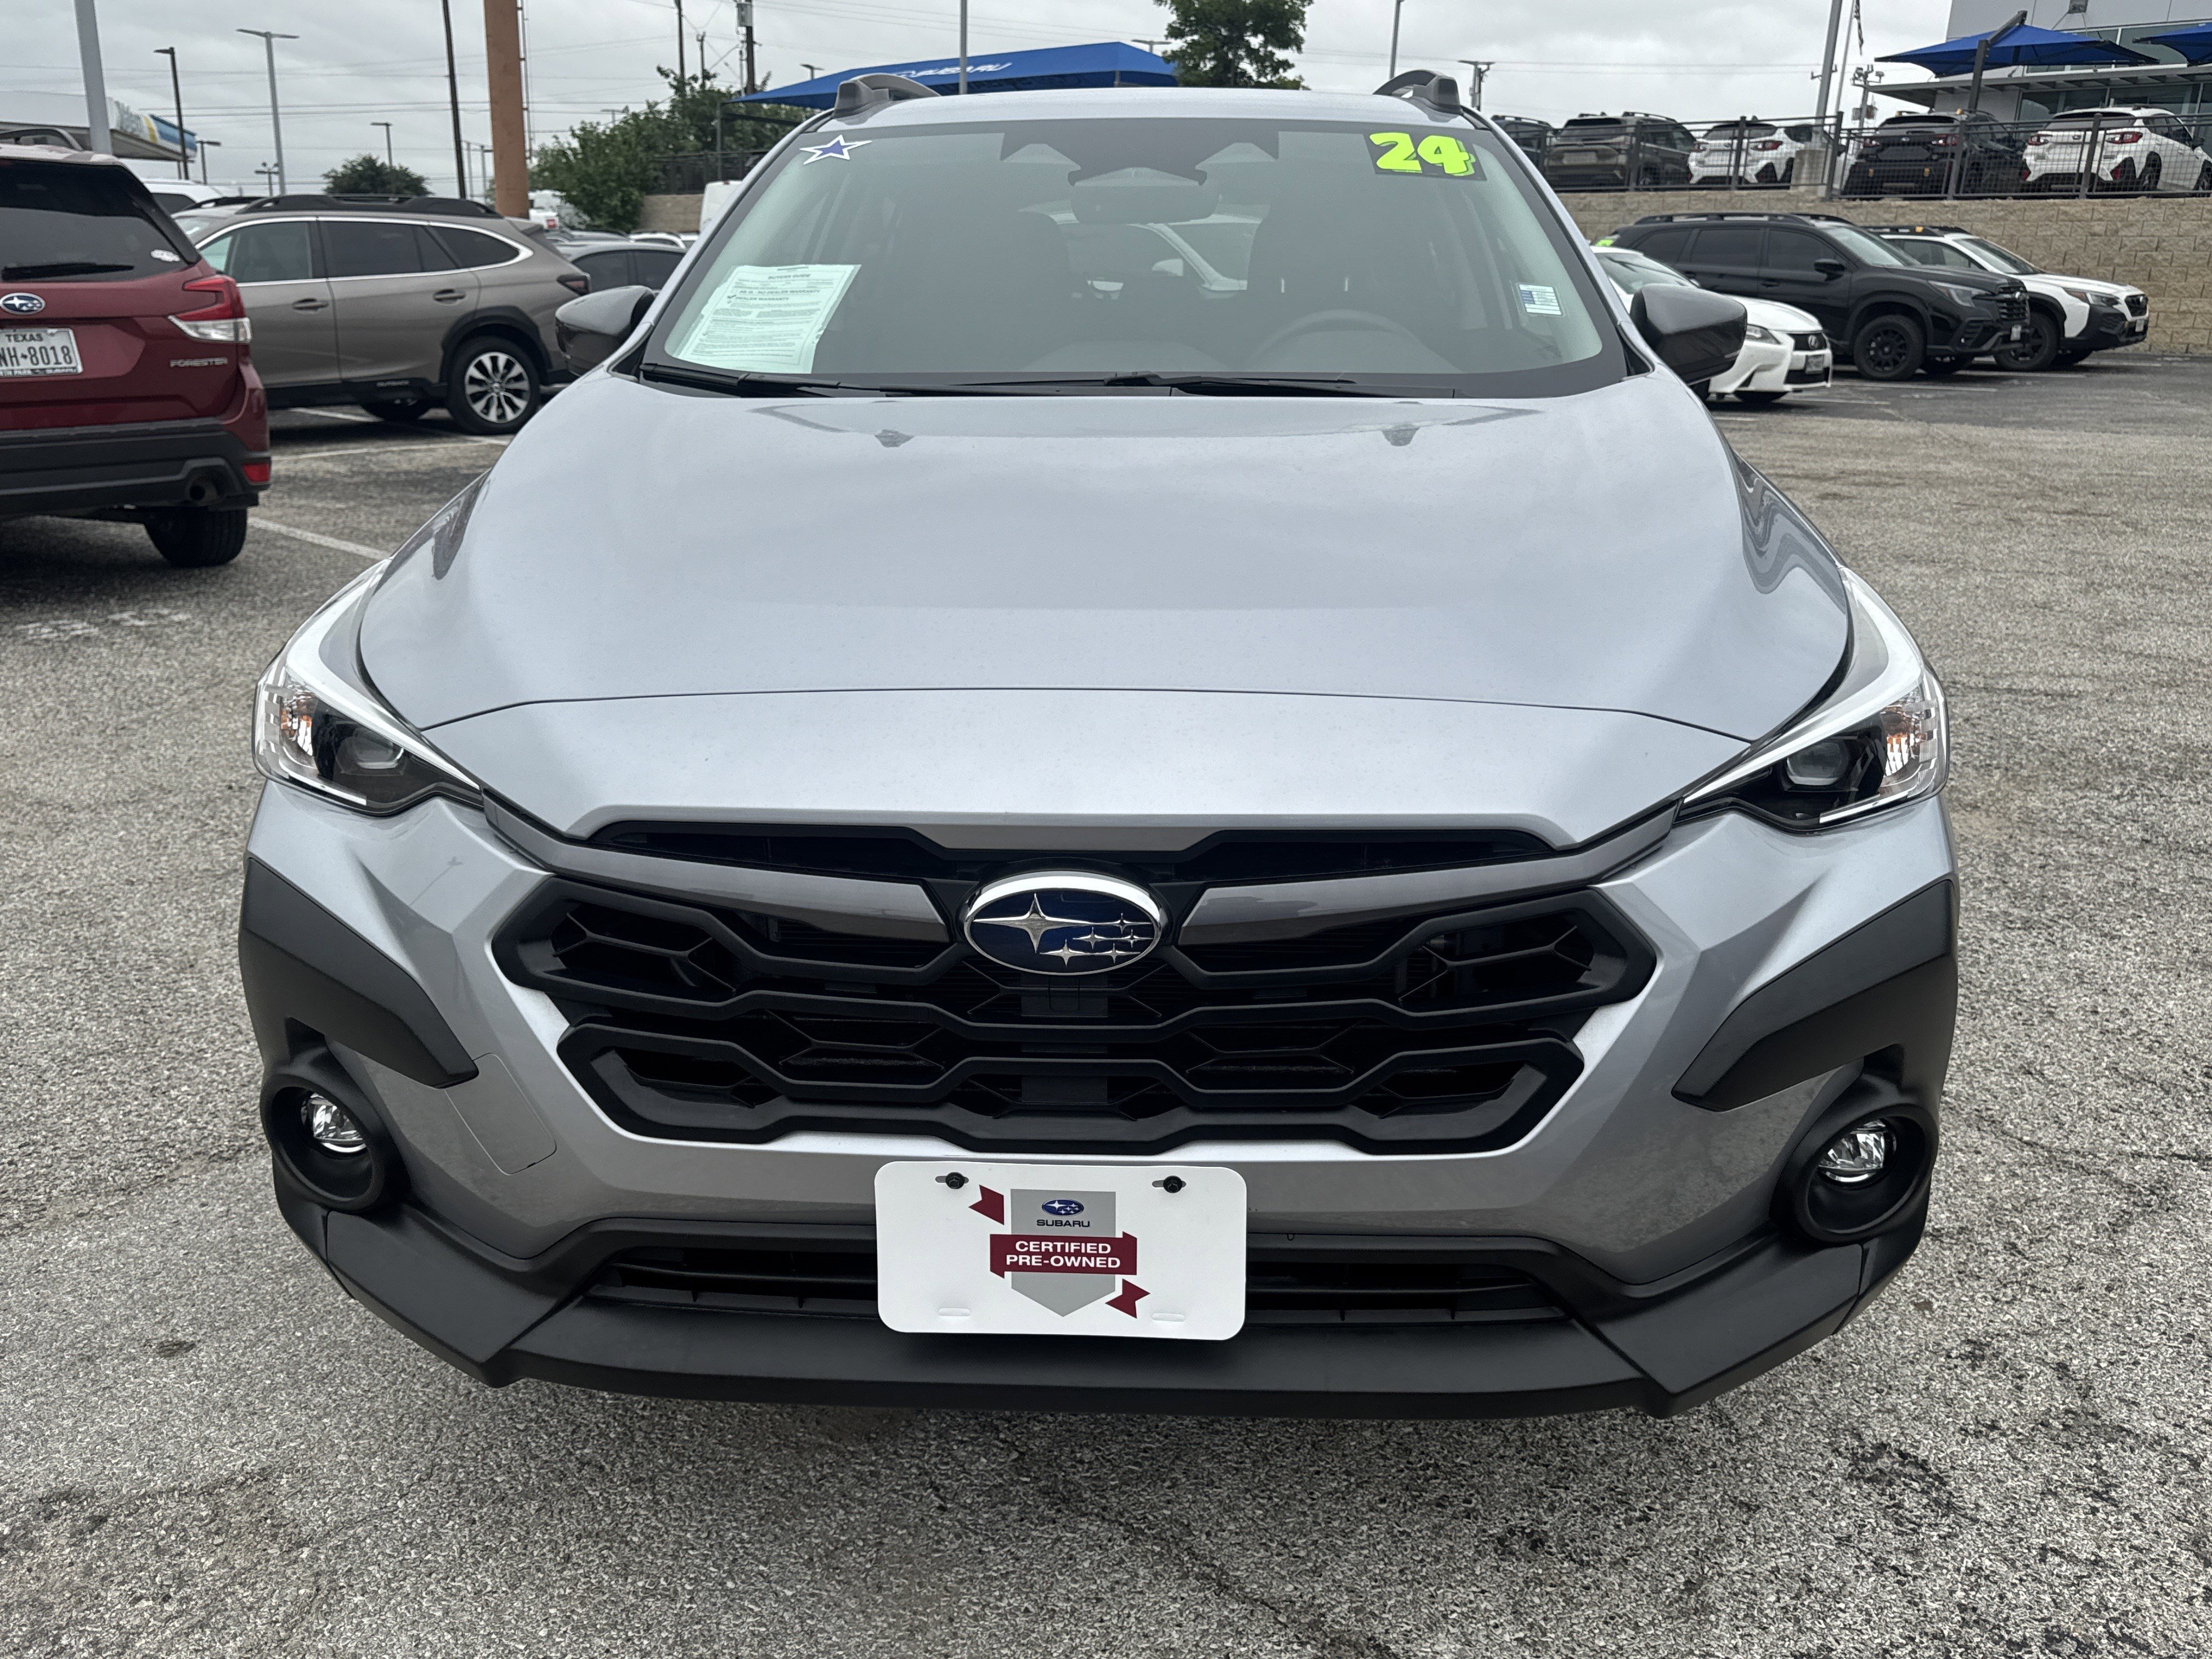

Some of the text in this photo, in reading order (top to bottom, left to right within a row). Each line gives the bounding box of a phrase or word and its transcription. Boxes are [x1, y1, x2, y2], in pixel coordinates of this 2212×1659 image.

[1369, 132, 1476, 176] 24
[5, 333, 43, 342] TEXAS
[170, 357, 228, 368] FORESTER
[1036, 1219, 1090, 1227] SUBARU
[1015, 1240, 1111, 1254] CERTIFIED
[1006, 1255, 1120, 1268] PRE-OWNED
